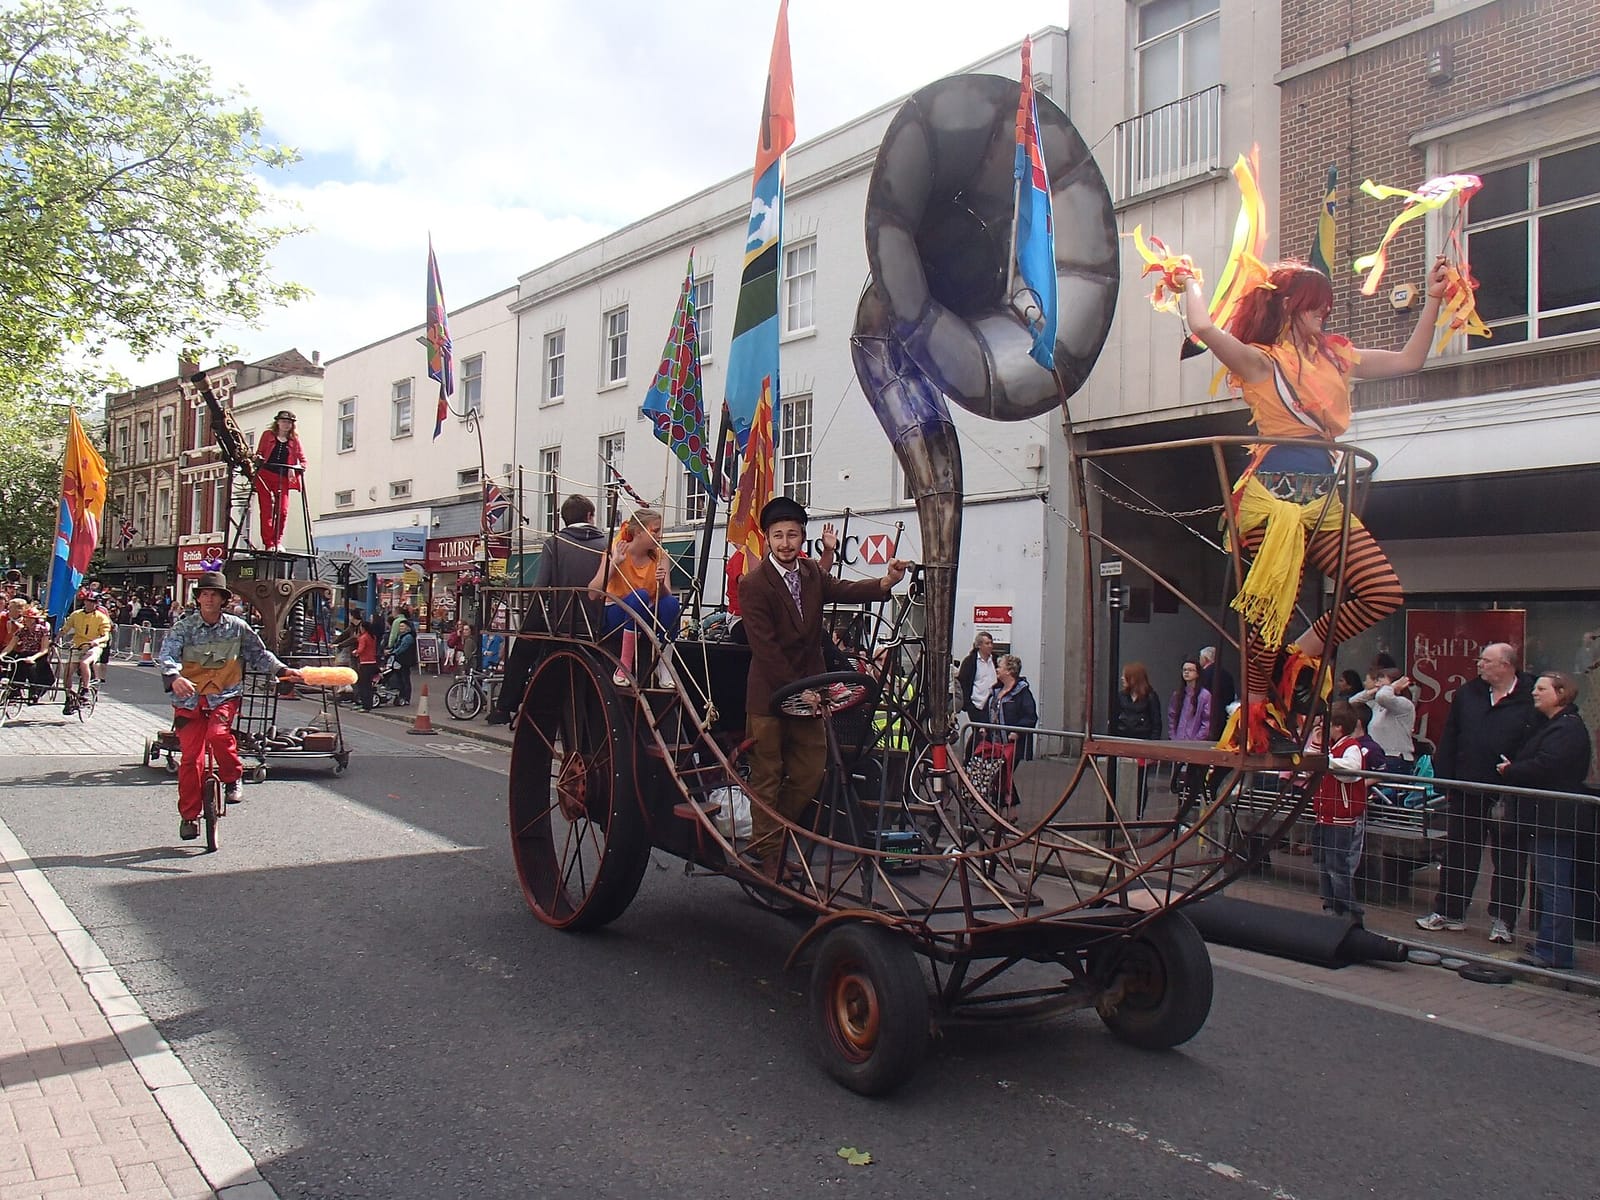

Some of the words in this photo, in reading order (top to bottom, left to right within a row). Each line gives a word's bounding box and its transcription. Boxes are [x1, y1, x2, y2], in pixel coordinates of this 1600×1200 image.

[183, 551, 202, 561] British
[976, 608, 989, 617] Free
[1414, 636, 1458, 657] Half
[1412, 657, 1467, 703] Sa
